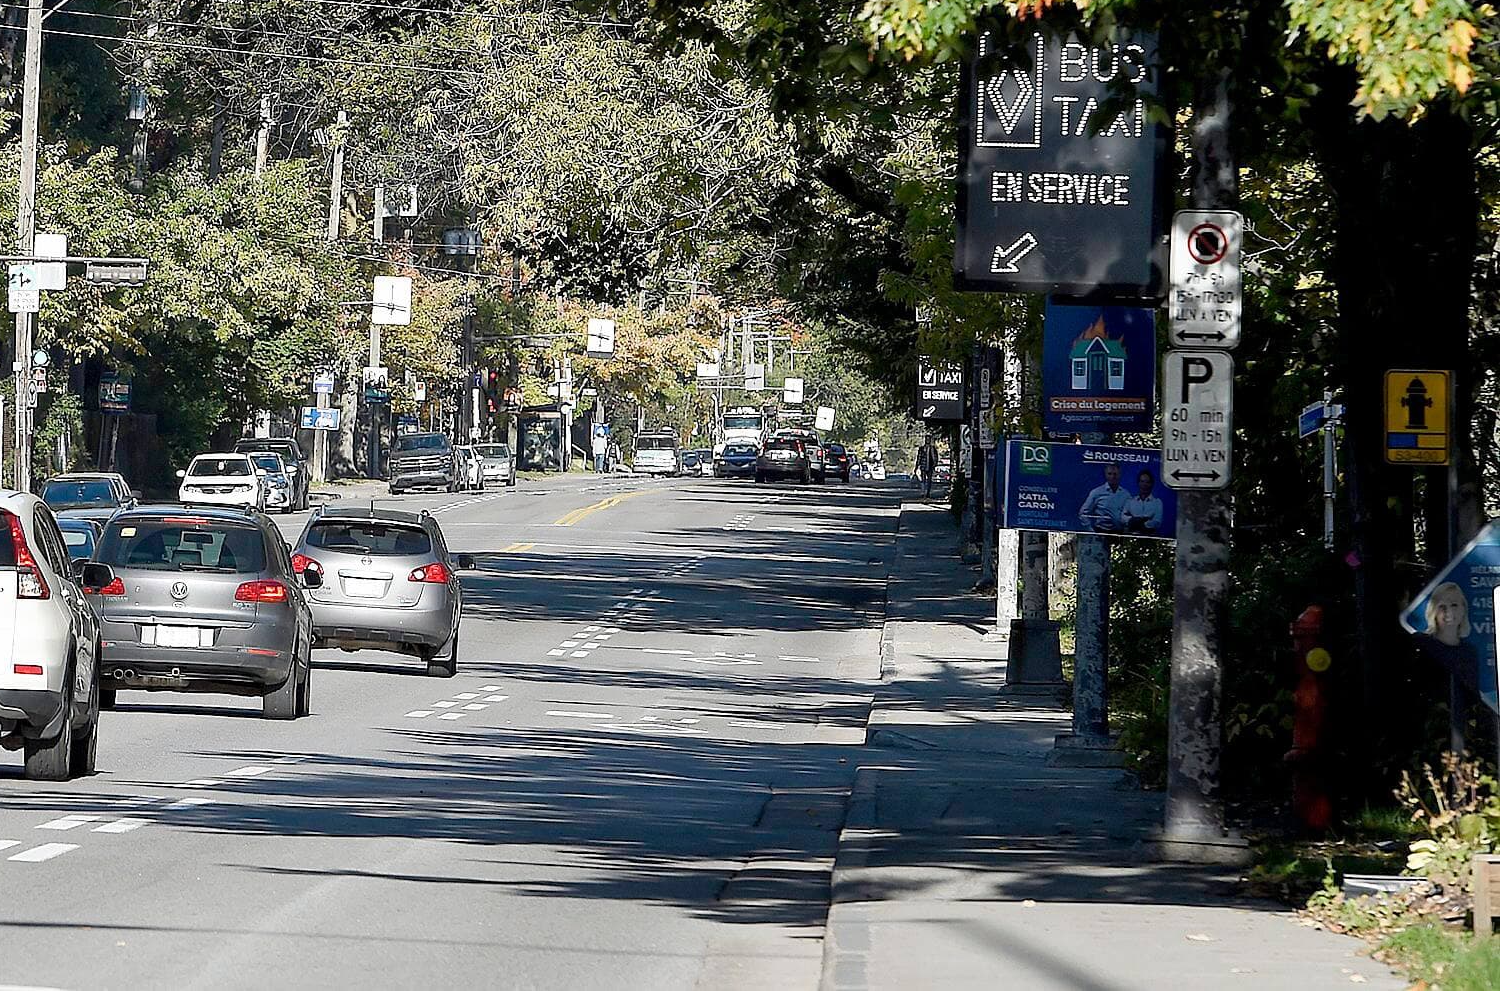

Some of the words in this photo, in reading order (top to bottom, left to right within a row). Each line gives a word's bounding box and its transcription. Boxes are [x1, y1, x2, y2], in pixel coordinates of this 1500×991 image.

[1060, 43, 1147, 83] BUS
[991, 171, 1023, 202] EN
[1027, 172, 1130, 205] SERVICE
[1181, 357, 1213, 404] P
[1051, 399, 1077, 410] Crise
[1079, 400, 1093, 410] du
[1094, 400, 1146, 412] logement
[1171, 408, 1188, 422] 60
[1200, 411, 1224, 423] min
[1171, 428, 1188, 442] 9h
[1202, 430, 1222, 443] 15h
[1095, 451, 1150, 464] ROUSSEAU
[1167, 448, 1188, 462] LUN
[1204, 450, 1226, 463] VEN
[1018, 492, 1049, 501] KATIA
[1018, 501, 1055, 509] GARON
